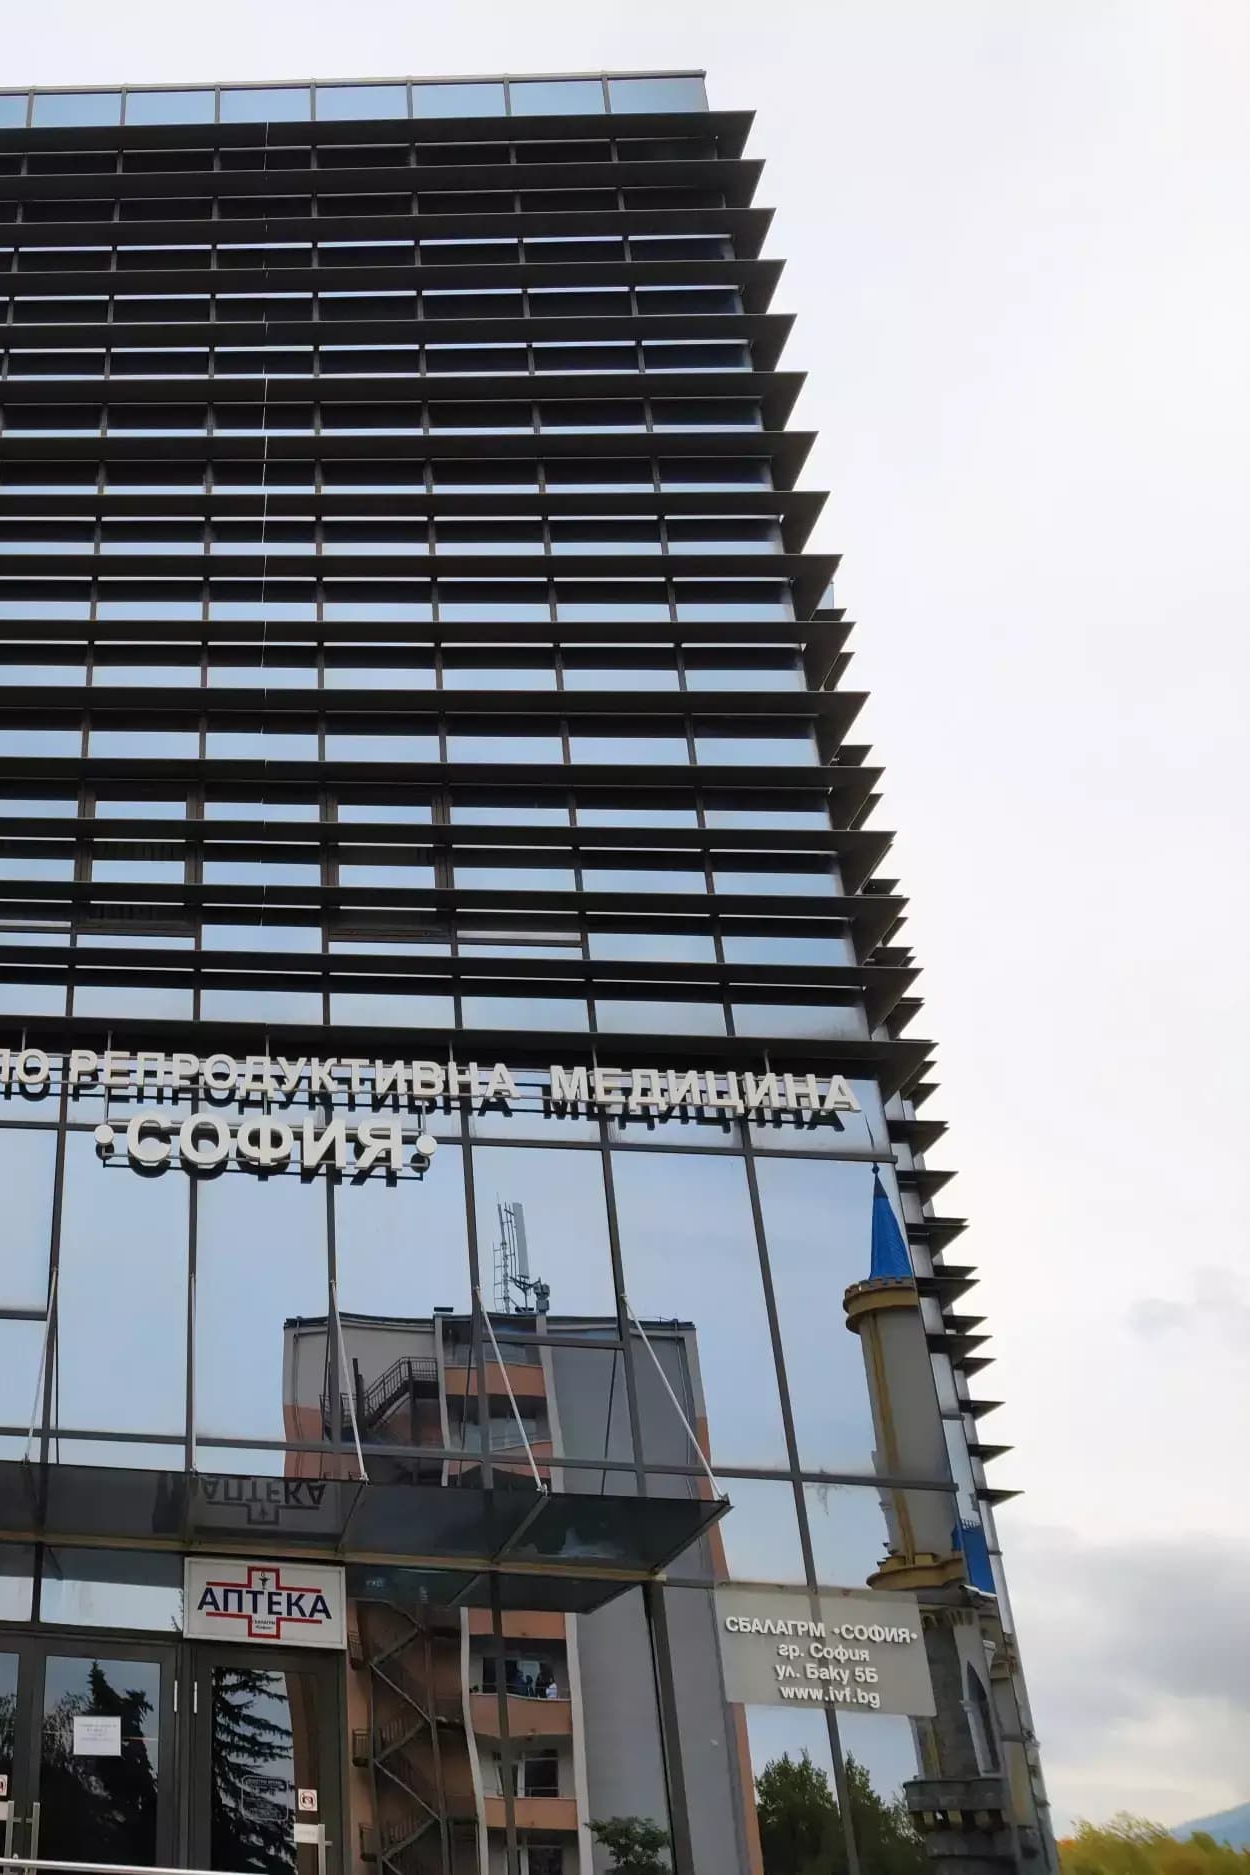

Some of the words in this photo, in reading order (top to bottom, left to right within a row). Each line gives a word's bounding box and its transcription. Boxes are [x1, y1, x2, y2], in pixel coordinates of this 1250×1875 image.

[70, 1049, 522, 1100] РЕПРОДУКТИВНА
[550, 1065, 862, 1115] МЕДИЦИНА
[197, 1587, 332, 1619] АПТЕКА
[725, 1615, 826, 1638] СБАЛАГРМ
[778, 1643, 805, 1659] гр.
[809, 1642, 870, 1663] София
[775, 1663, 800, 1680] ул.
[805, 1662, 850, 1685] Баку
[854, 1666, 879, 1684] 5Б
[781, 1686, 881, 1708] www.ivf.bg
